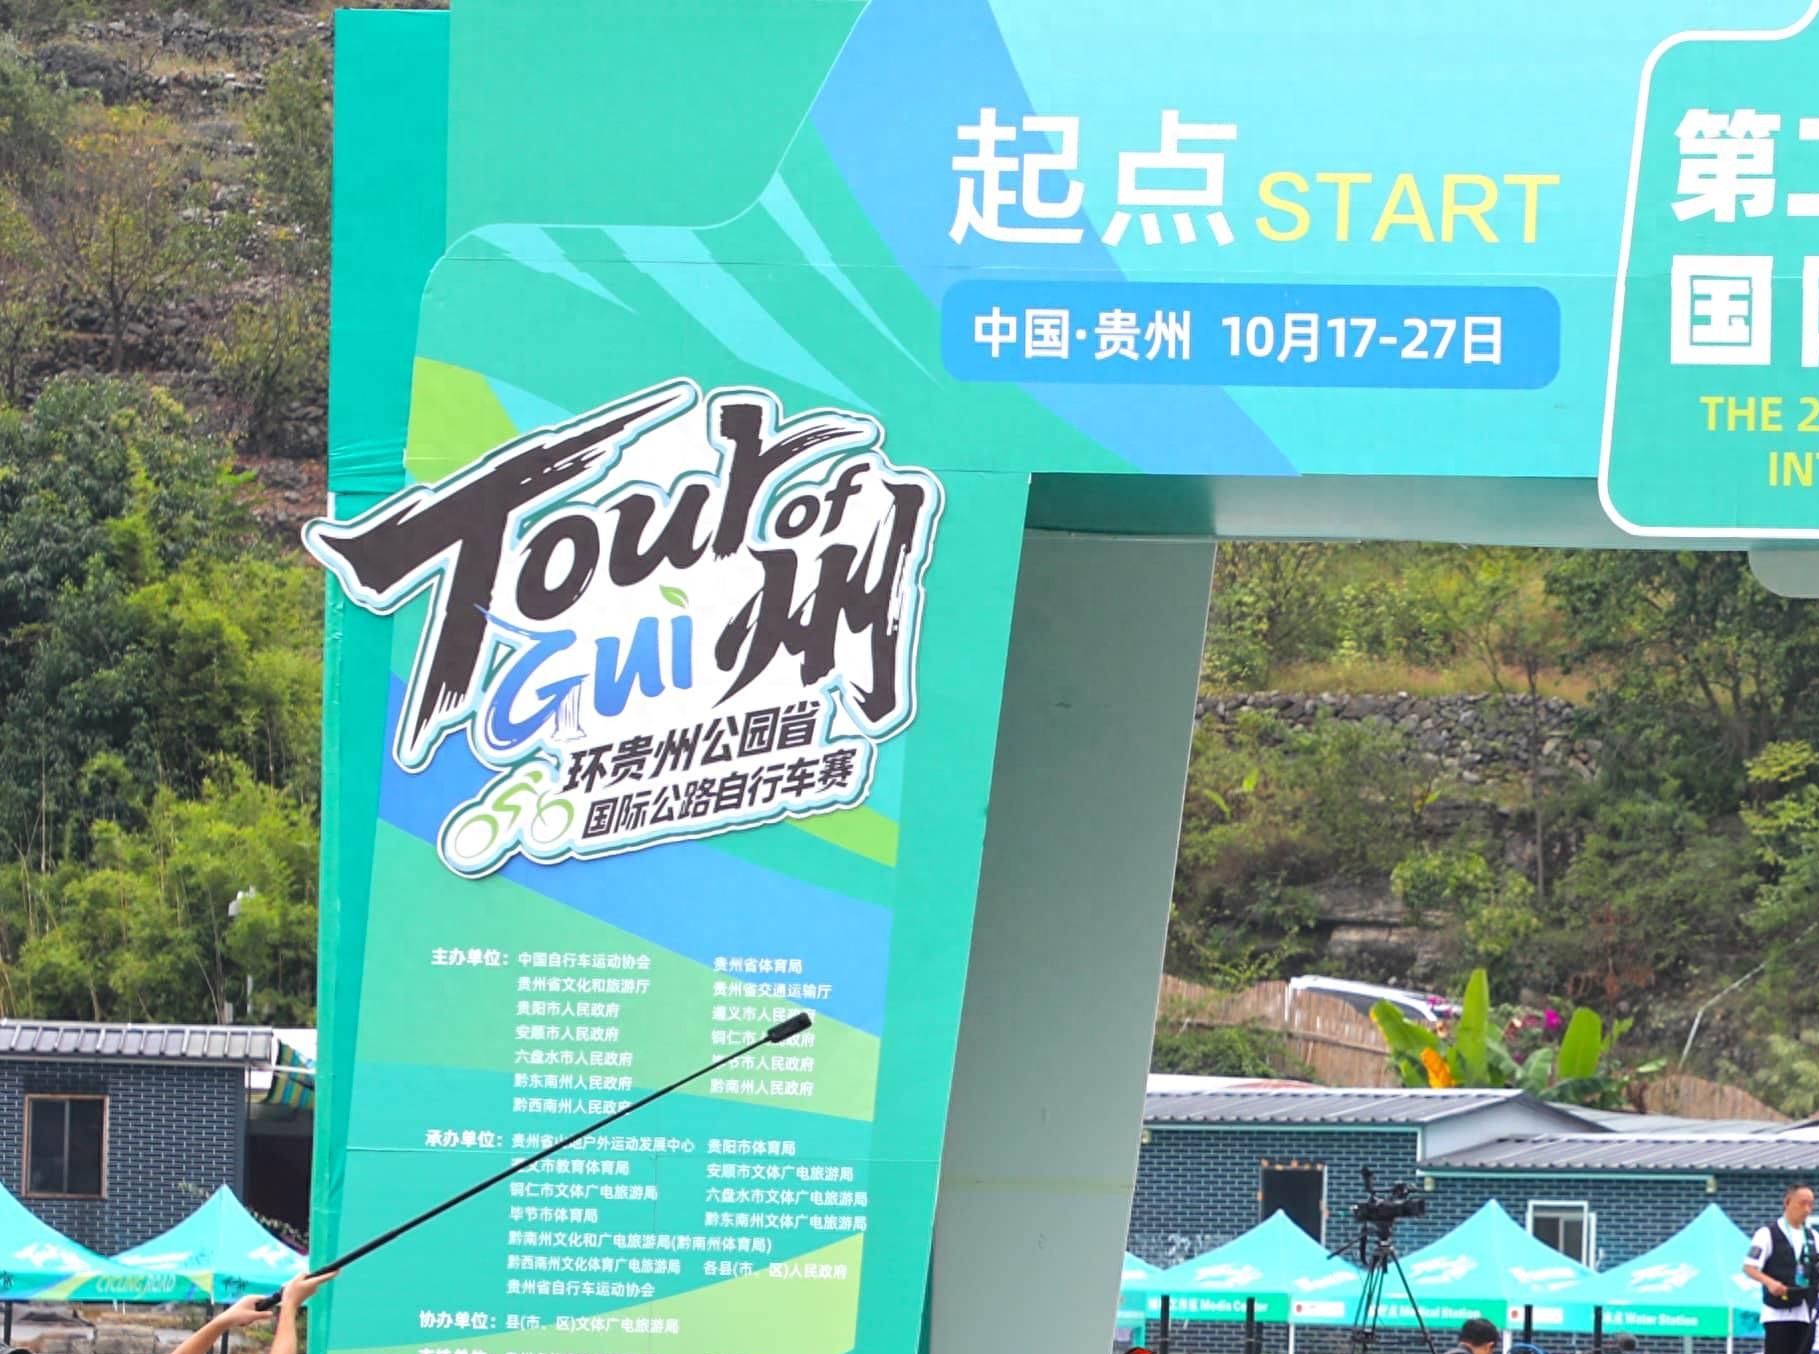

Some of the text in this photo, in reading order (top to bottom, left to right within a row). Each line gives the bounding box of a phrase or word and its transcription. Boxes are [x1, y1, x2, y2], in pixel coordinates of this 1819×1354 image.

[949, 105, 1561, 247] 起点 START
[973, 307, 1503, 366] 中国·贵州 10月17-27日
[1699, 396, 1783, 432] THE
[562, 700, 821, 796] 环贵州公园省
[581, 748, 859, 840] 国际公路自行车赛
[517, 951, 652, 971] 中国自行车运动协会
[713, 956, 803, 975] 贵州省体育局
[517, 975, 651, 996] 贵州省文化和旅游厅
[712, 981, 833, 1000] 贵州省交通运输厅
[516, 1000, 620, 1019] 贵阳市人民政府
[515, 1025, 620, 1043] 安顺市人民政府
[711, 1029, 816, 1048] 铜仁市政府
[514, 1049, 633, 1068] 六盘水市人民政府
[513, 1073, 633, 1093] 黔东南州人民政府
[710, 1078, 815, 1097] 黔南州人民政府
[707, 1139, 797, 1157] 贵阳市体育局
[706, 1163, 854, 1183] 安顺市文体广电旅游局
[510, 1182, 659, 1201] 铜仁市文体广电旅游局
[705, 1187, 868, 1208] 六盘水市文体广电旅游局
[509, 1206, 599, 1224] 毕节市体育局
[704, 1211, 868, 1232] 黔东南州文体广电旅游局
[506, 1279, 656, 1298] 贵州省自行车运动协会
